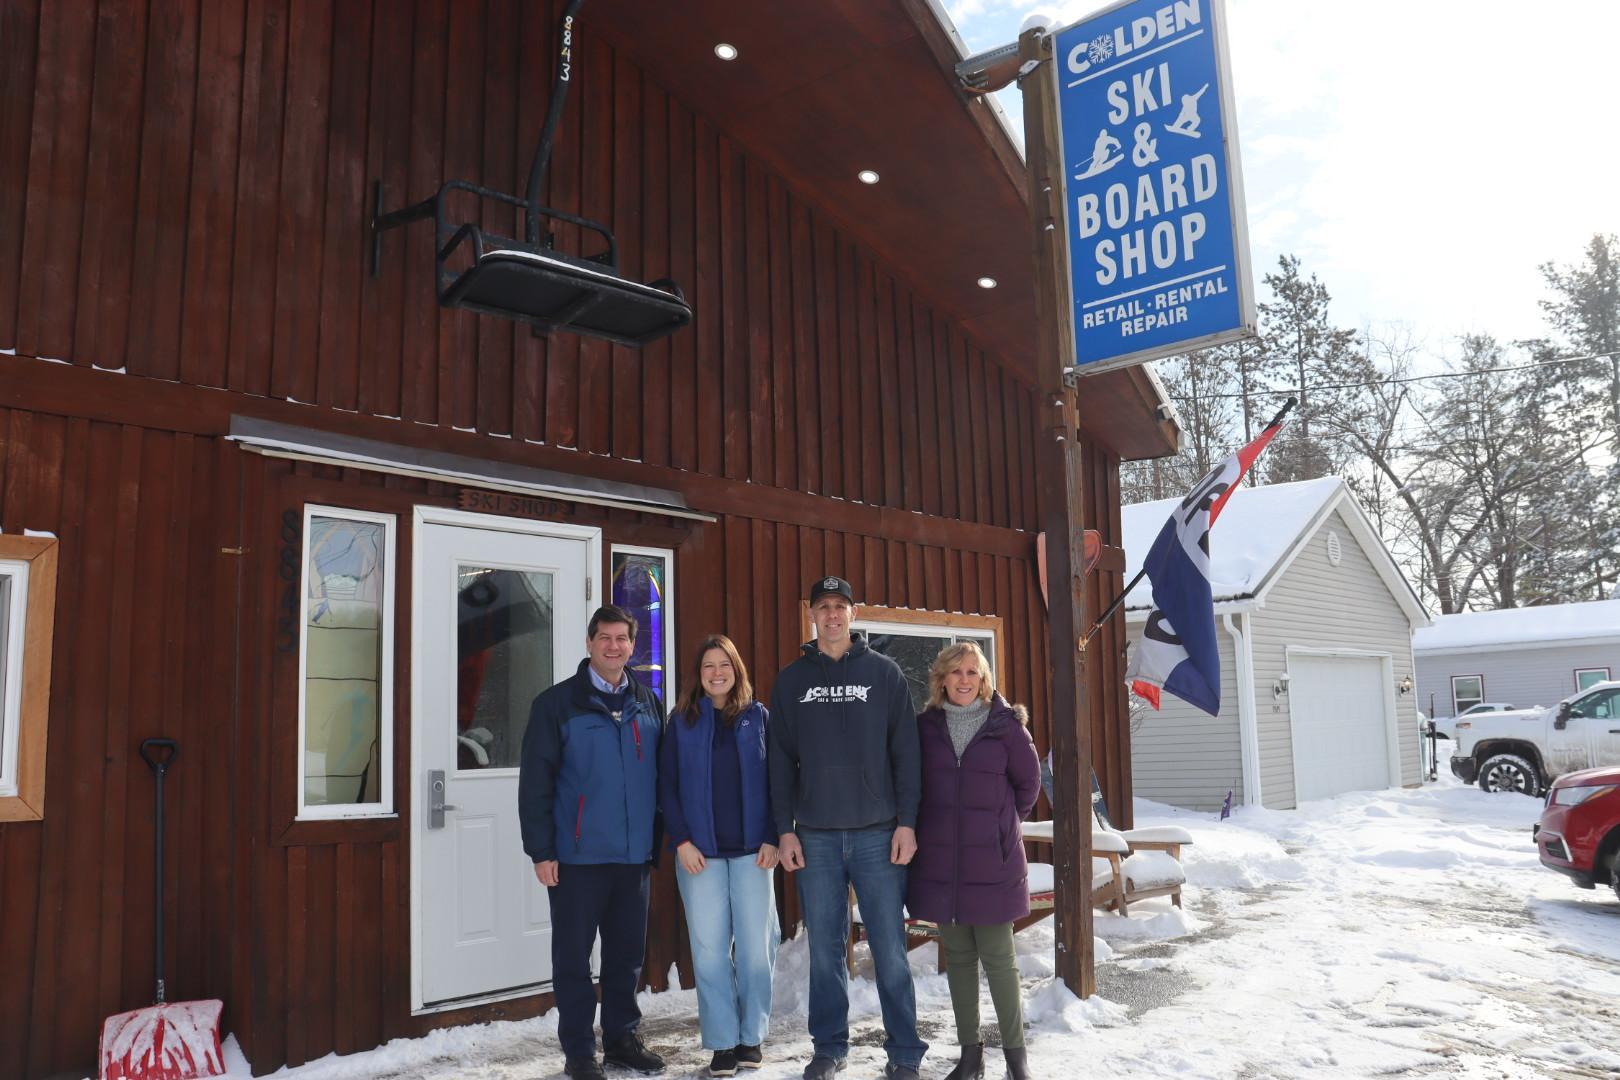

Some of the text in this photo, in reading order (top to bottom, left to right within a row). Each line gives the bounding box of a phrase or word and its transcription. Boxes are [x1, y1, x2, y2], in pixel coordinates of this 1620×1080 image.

[1107, 62, 1172, 126] SKI
[1132, 121, 1160, 168] &
[1077, 153, 1218, 240] BOARD
[1094, 212, 1206, 286] SHOP
[1083, 276, 1228, 329] RETAIL RENTAL
[1121, 306, 1188, 337] REPAIR
[469, 492, 559, 517] SKI SHOP
